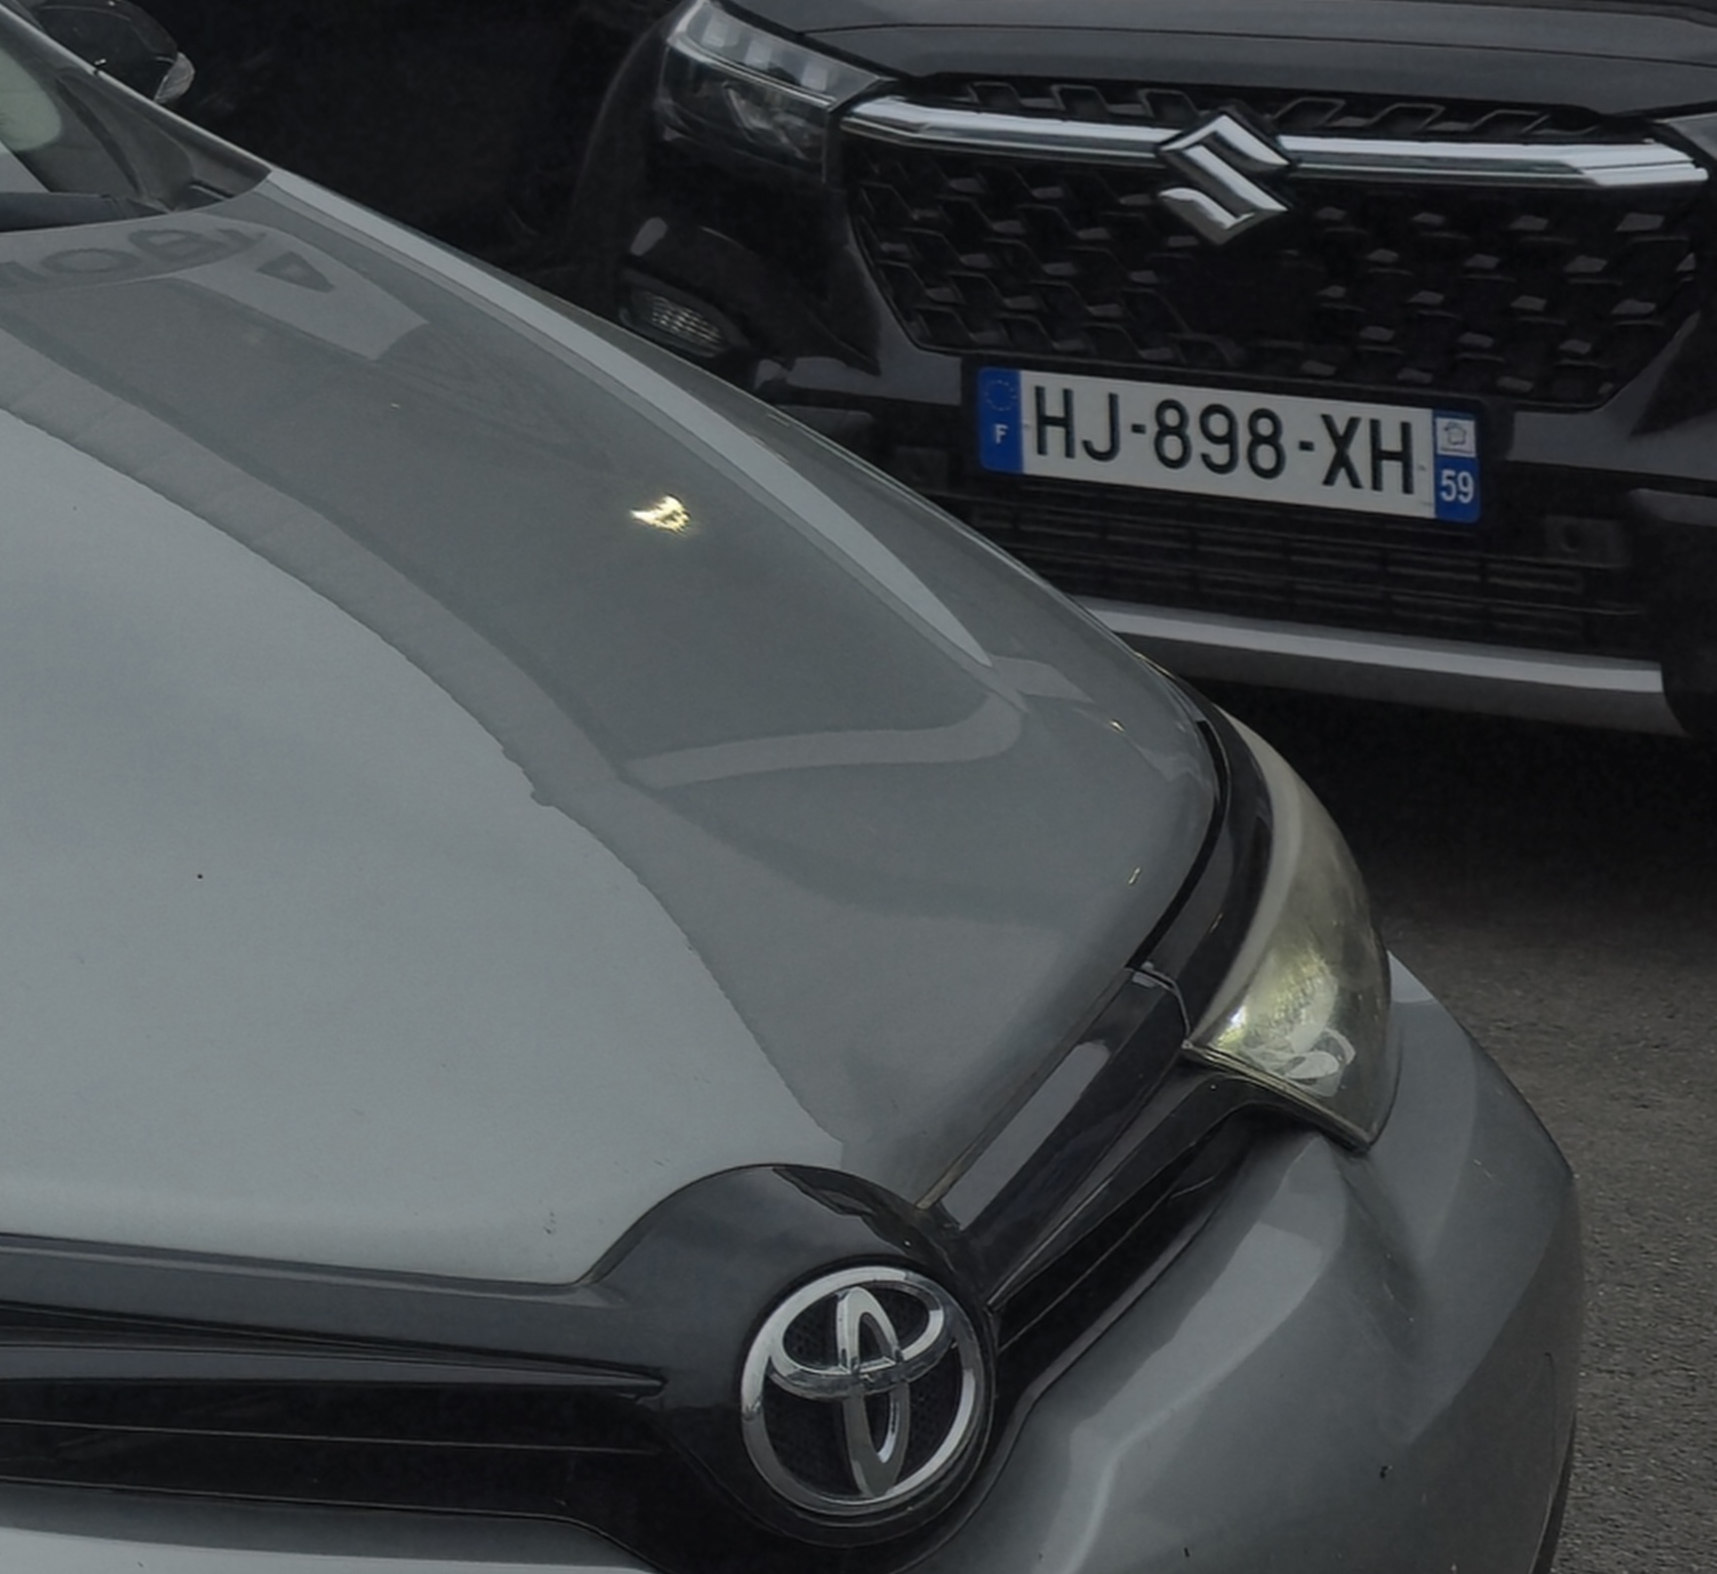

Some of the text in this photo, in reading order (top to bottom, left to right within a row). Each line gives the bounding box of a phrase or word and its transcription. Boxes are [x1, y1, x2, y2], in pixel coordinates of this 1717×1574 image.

[994, 424, 1009, 447] F
[1034, 385, 1414, 495] HJ-898-XH
[1439, 468, 1475, 505] 59
